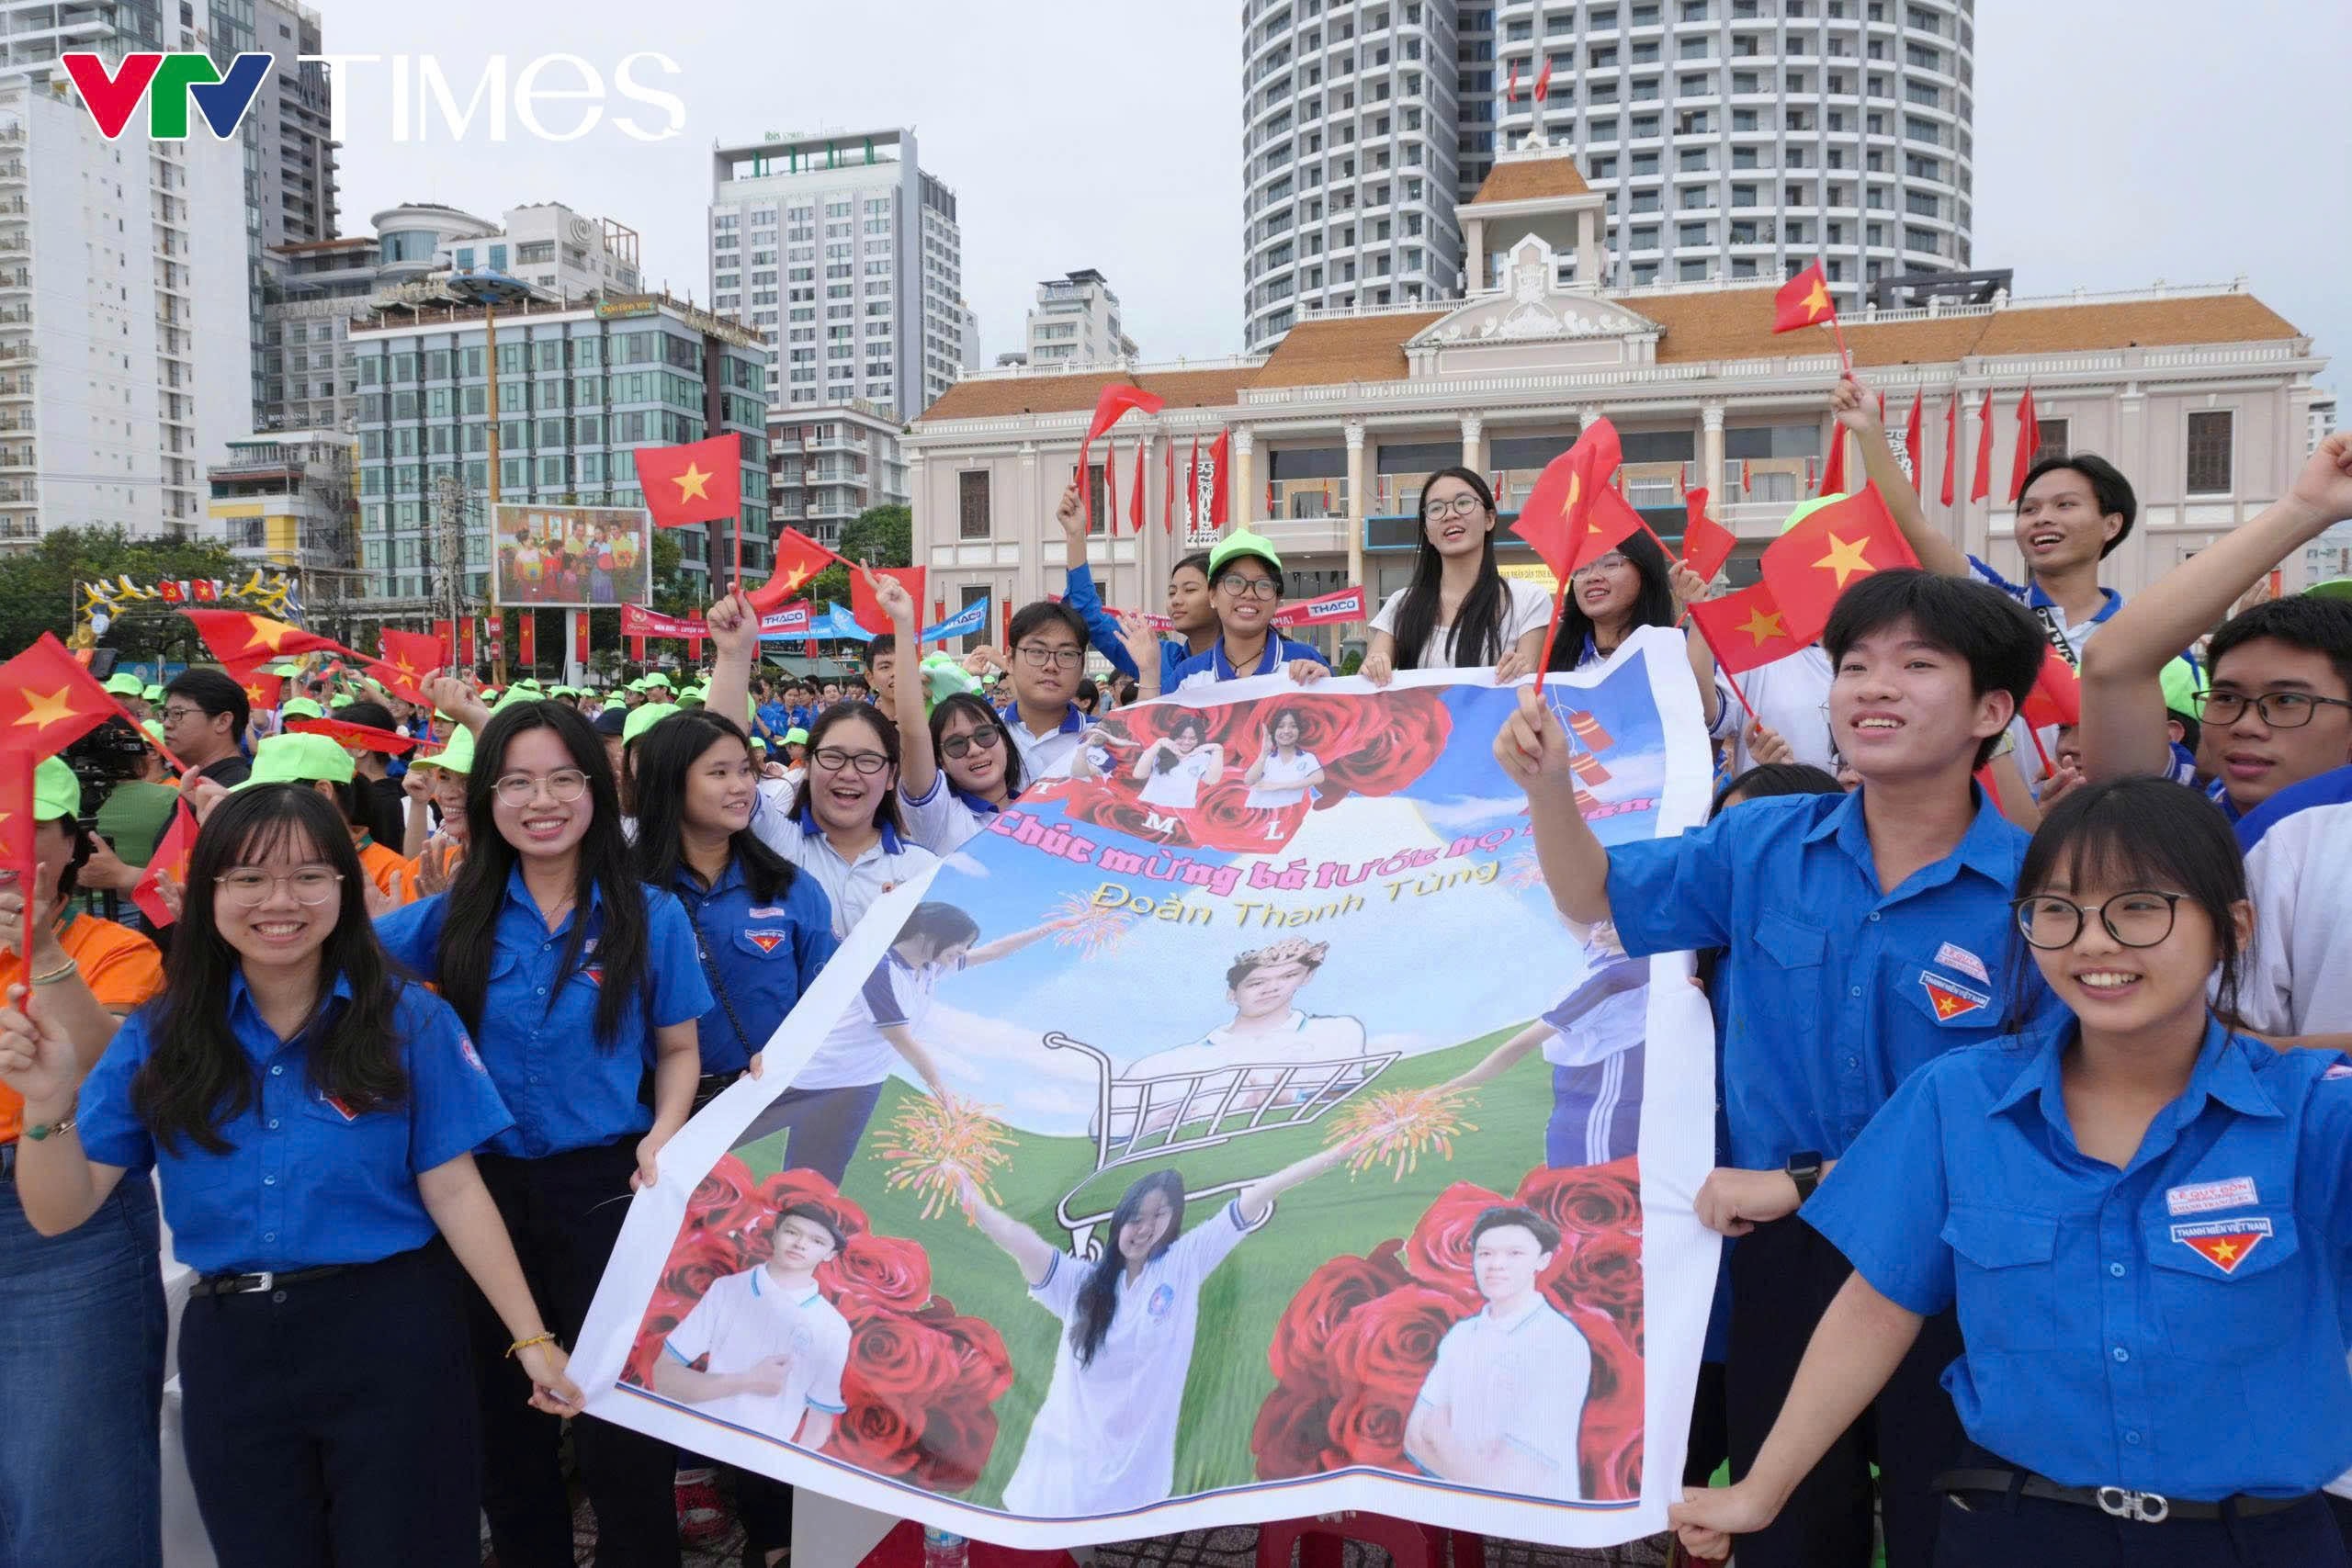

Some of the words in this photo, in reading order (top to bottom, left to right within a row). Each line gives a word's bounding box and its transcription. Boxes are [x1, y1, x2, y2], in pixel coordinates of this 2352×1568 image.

[1310, 600, 1356, 614] THACO
[764, 611, 803, 626] THACO
[1035, 781, 1057, 795] T
[1141, 812, 1178, 834] M
[1263, 820, 1284, 841] L
[988, 809, 1099, 863] Chúc
[1095, 846, 1245, 897] mừng
[1246, 858, 1311, 890] bá
[1314, 847, 1442, 889] tước
[1443, 827, 1515, 858] họ
[1091, 882, 1213, 925] Đoàn
[1232, 893, 1365, 929] Thanh
[1382, 860, 1501, 902] Tùng
[2247, 1222, 2267, 1233] NAM
